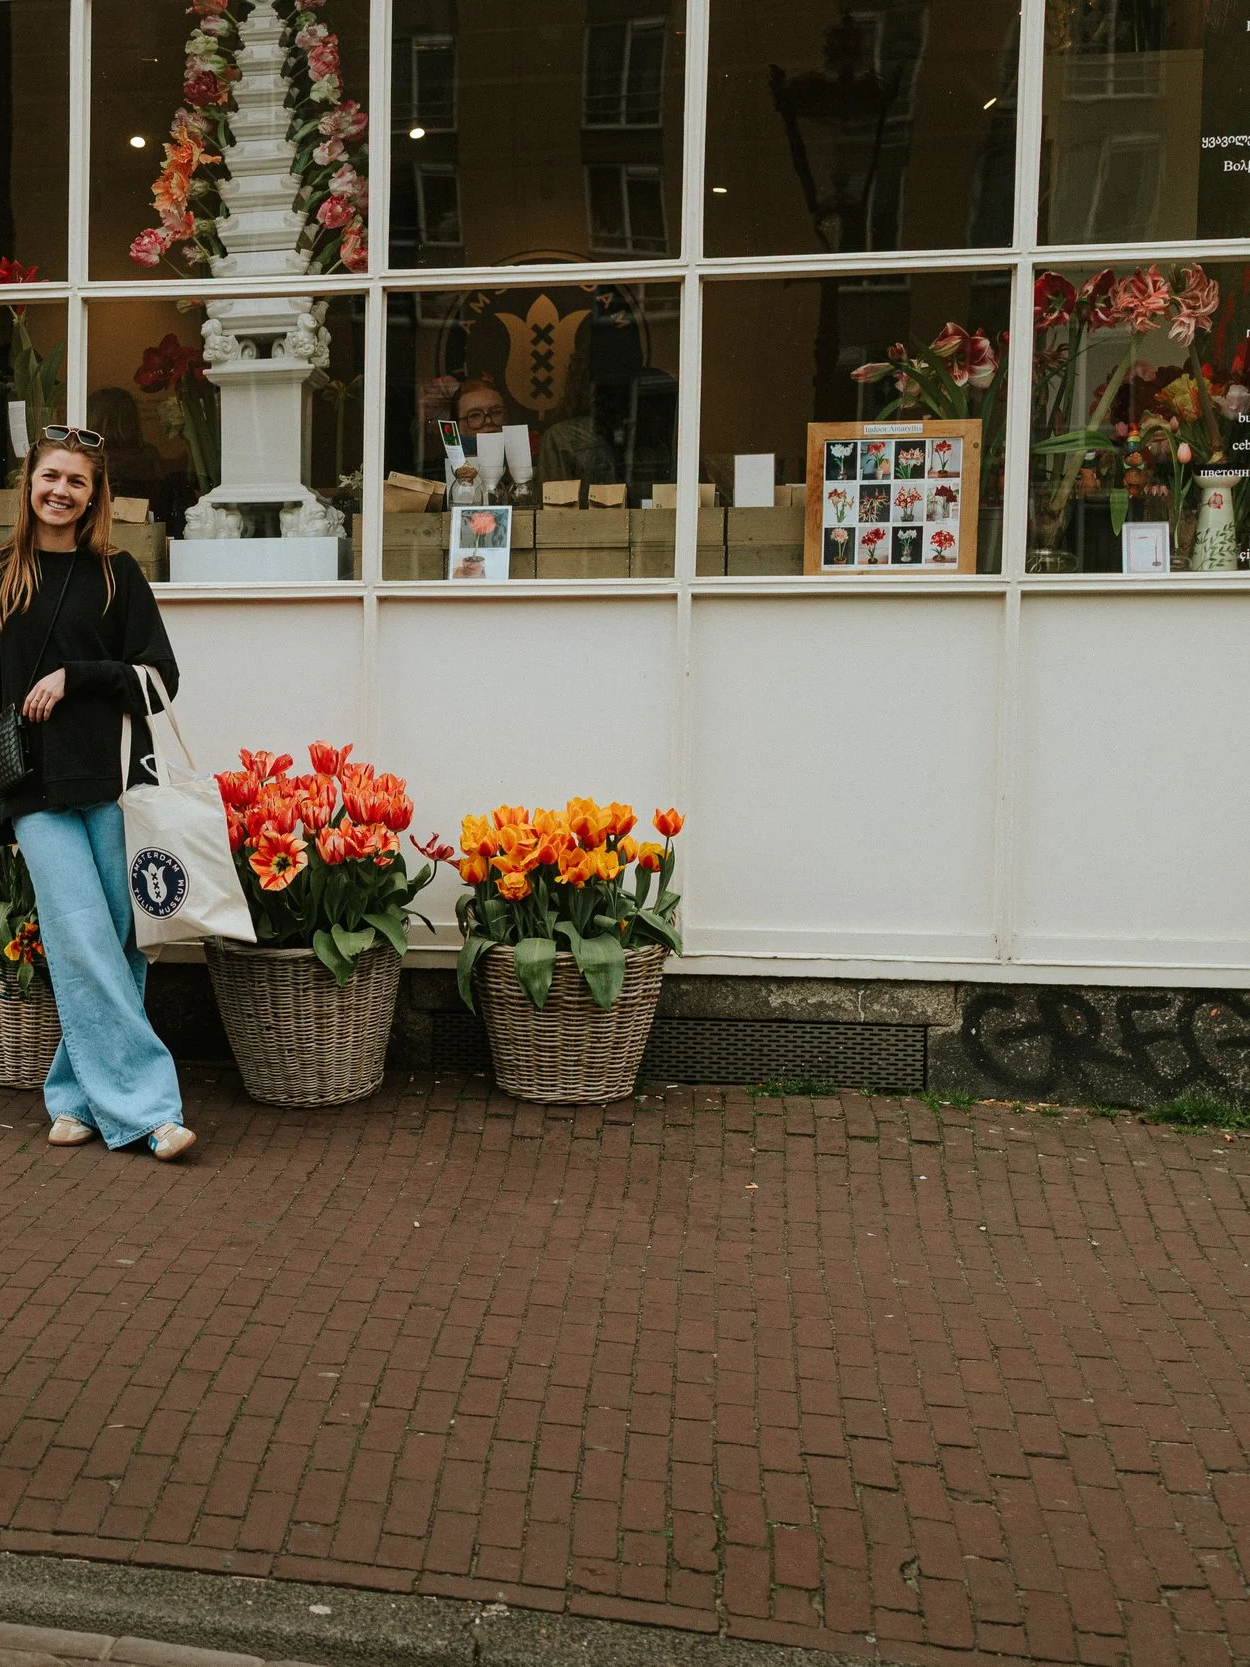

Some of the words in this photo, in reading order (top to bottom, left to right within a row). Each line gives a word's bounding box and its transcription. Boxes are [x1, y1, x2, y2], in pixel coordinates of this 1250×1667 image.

[133, 852, 180, 878] AMSTERDAM
[134, 888, 154, 912] TULIP
[159, 879, 184, 915] MUSEUM
